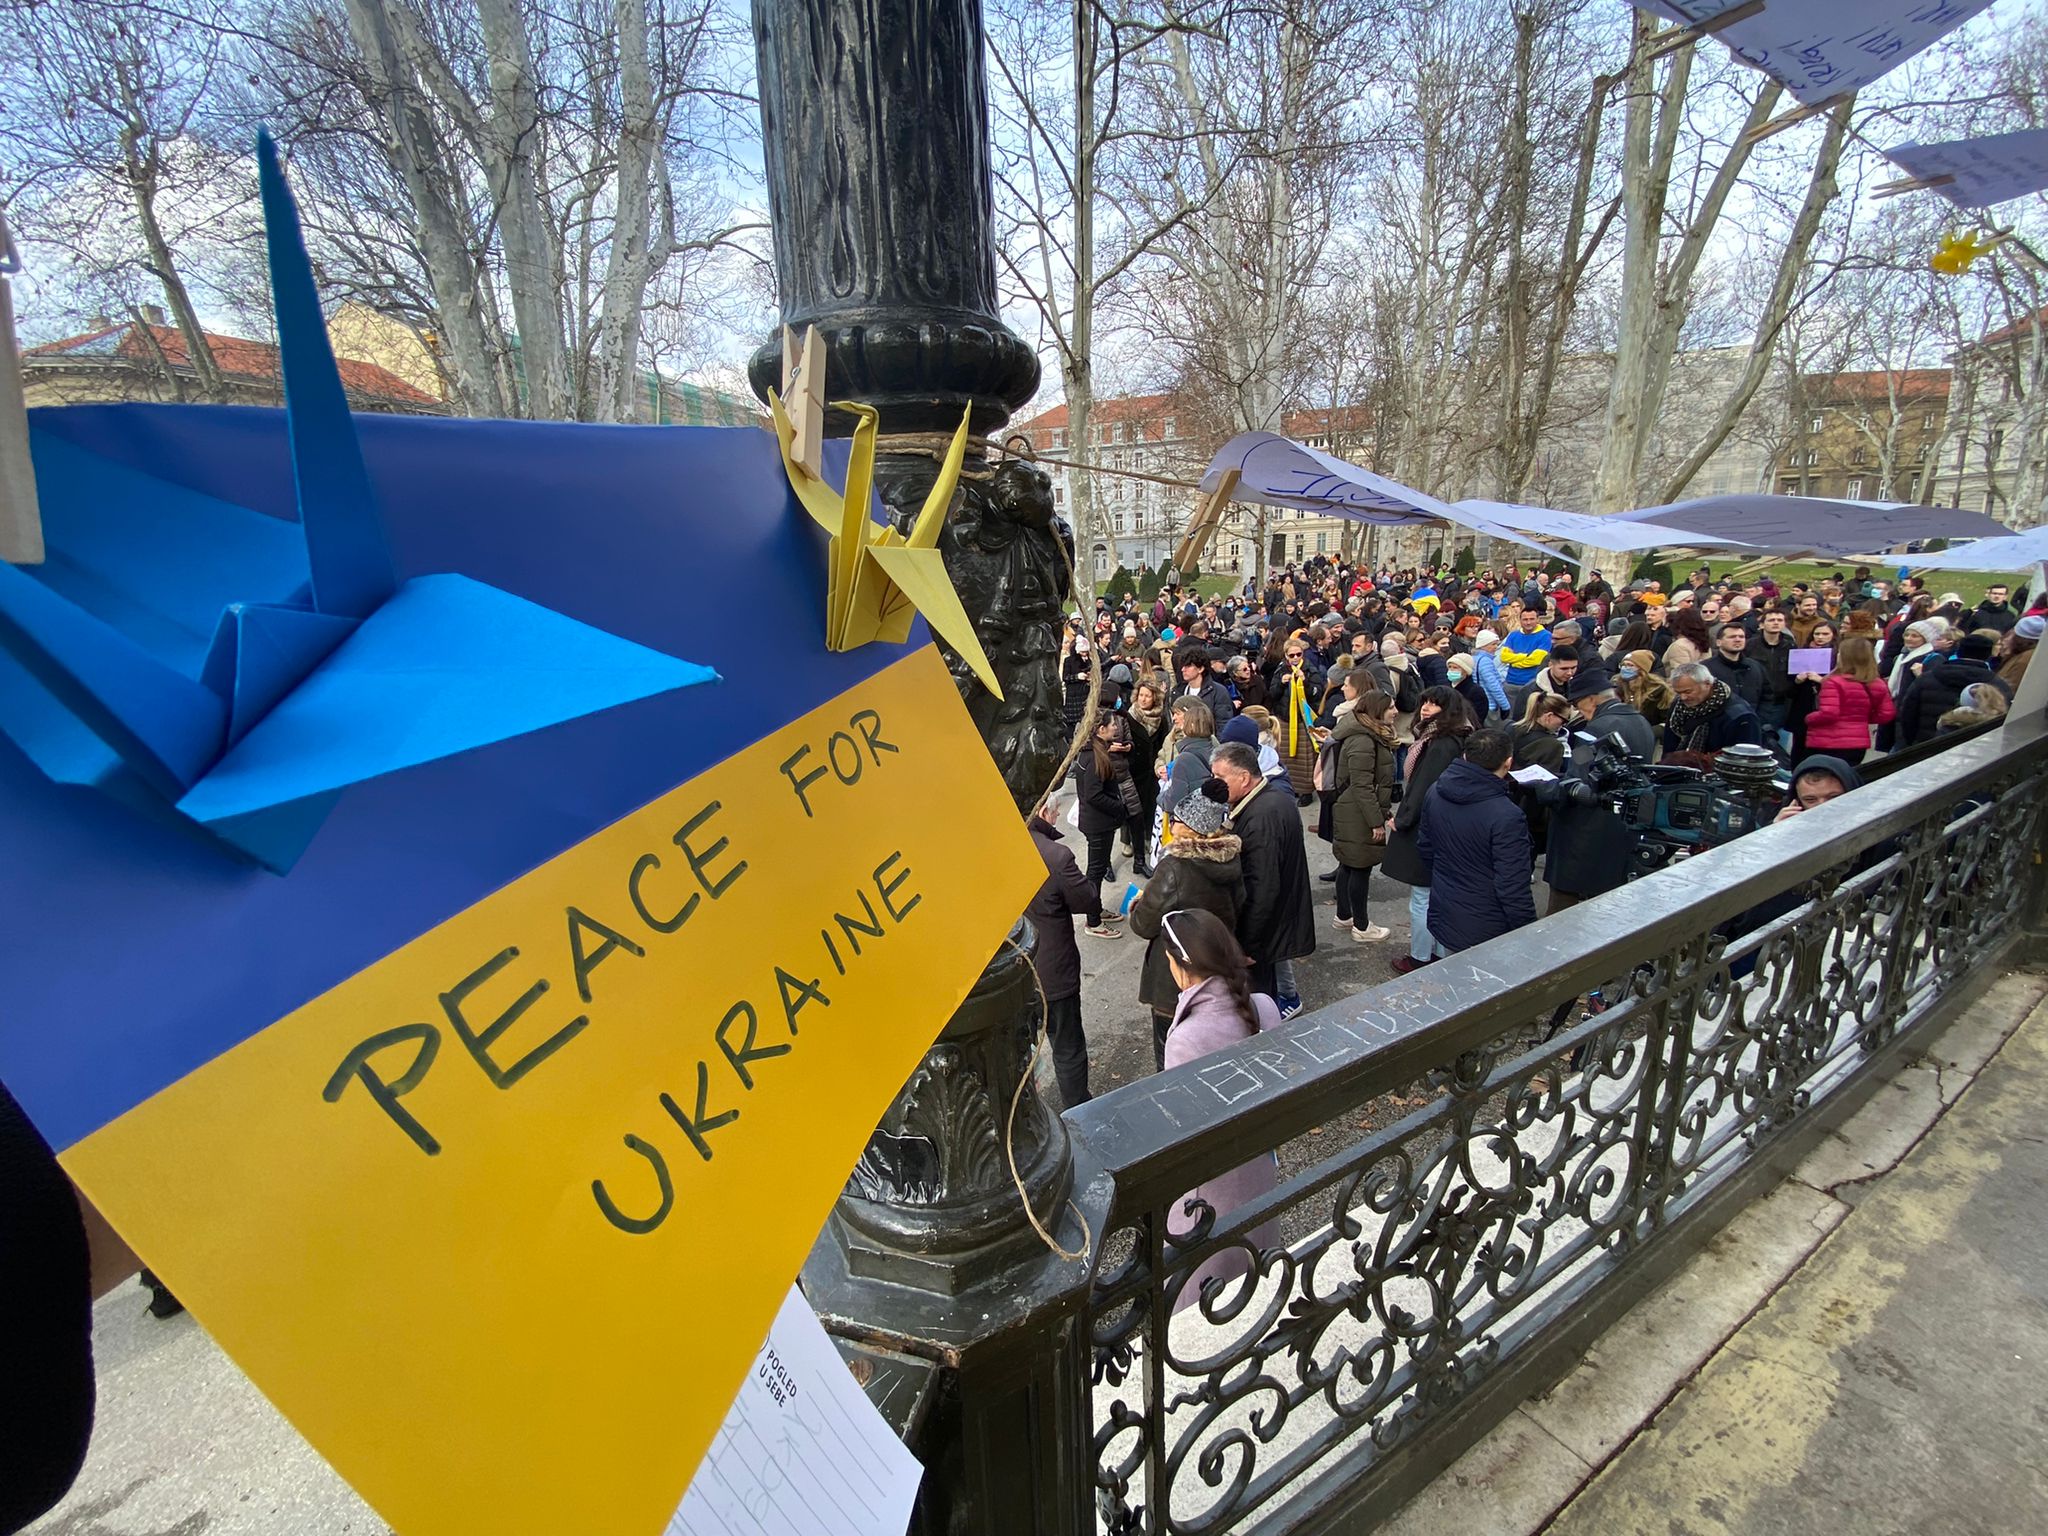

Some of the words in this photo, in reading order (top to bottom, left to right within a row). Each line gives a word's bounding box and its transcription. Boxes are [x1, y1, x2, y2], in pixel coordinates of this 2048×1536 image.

[322, 800, 749, 1156] PEACE
[780, 709, 900, 817] FOR
[592, 851, 922, 1235] UKRAINE
[759, 1363, 768, 1378] U
[765, 1375, 787, 1408] SEBE
[766, 1349, 797, 1398] POGLED
